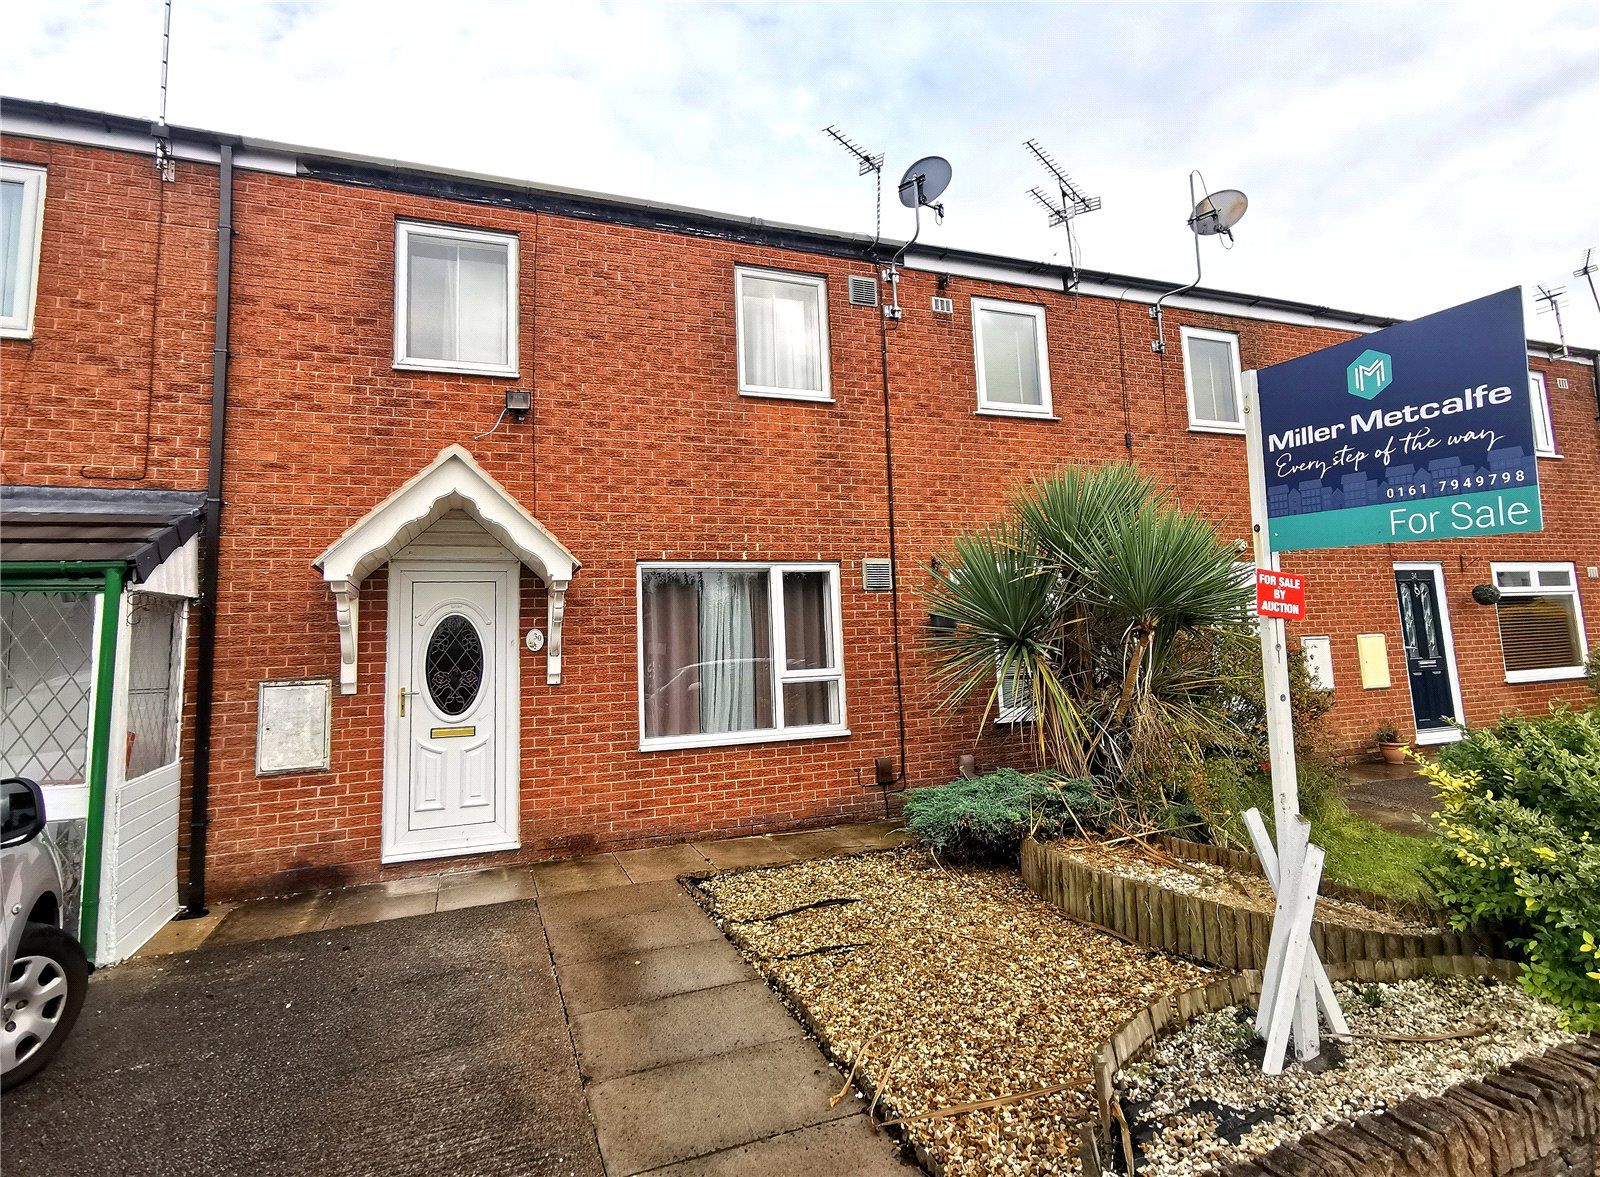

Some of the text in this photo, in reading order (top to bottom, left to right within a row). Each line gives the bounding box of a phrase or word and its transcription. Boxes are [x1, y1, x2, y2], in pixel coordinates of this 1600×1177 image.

[1268, 384, 1512, 453] Miller Metcalfe
[1275, 426, 1506, 480] Every step of the way
[1386, 470, 1526, 499] 0161 7949798
[1390, 495, 1531, 536] For Sale
[1259, 573, 1301, 590] FOR SALE
[1273, 588, 1286, 600] BY
[1261, 600, 1300, 615] AUCTION
[533, 632, 542, 642] 30
